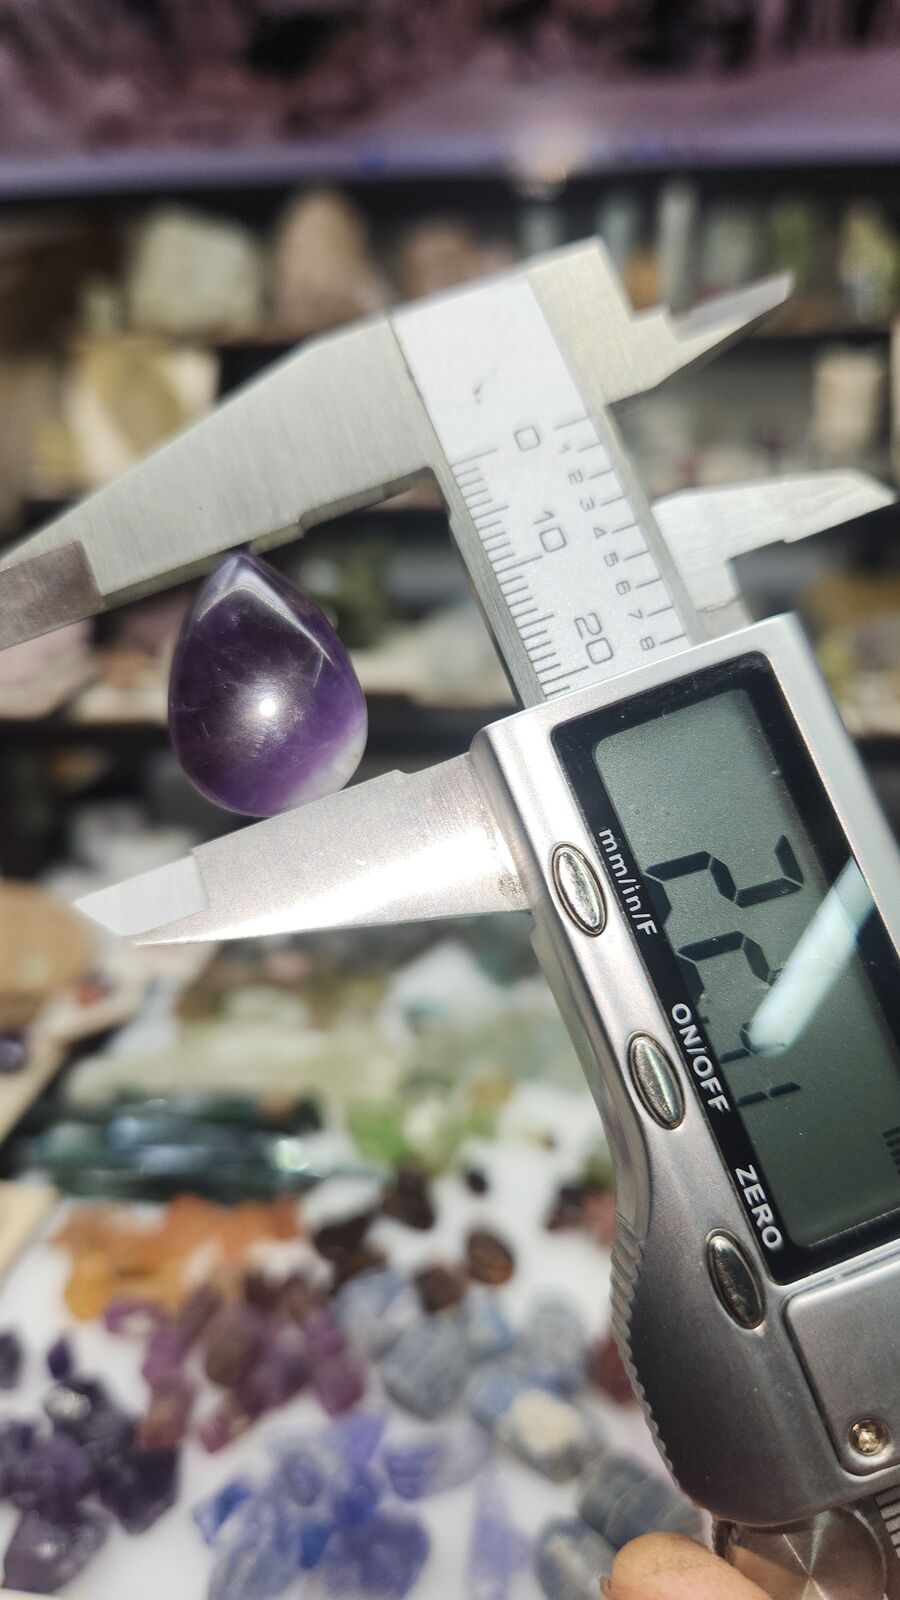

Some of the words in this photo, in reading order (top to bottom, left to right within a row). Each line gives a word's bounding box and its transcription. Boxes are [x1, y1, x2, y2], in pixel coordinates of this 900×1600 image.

[513, 425, 541, 452] 0
[532, 511, 567, 552] 10
[574, 613, 614, 664] 20
[567, 468, 584, 485] 2
[579, 497, 595, 513] 3
[593, 527, 608, 540] 4
[603, 551, 620, 568] 5
[615, 580, 632, 596] 6
[627, 608, 644, 620] 7
[640, 636, 656, 651] 8
[598, 828, 658, 935] mm/in/F
[671, 1003, 731, 1113] ON/OFF
[735, 1164, 783, 1250] ZERO
